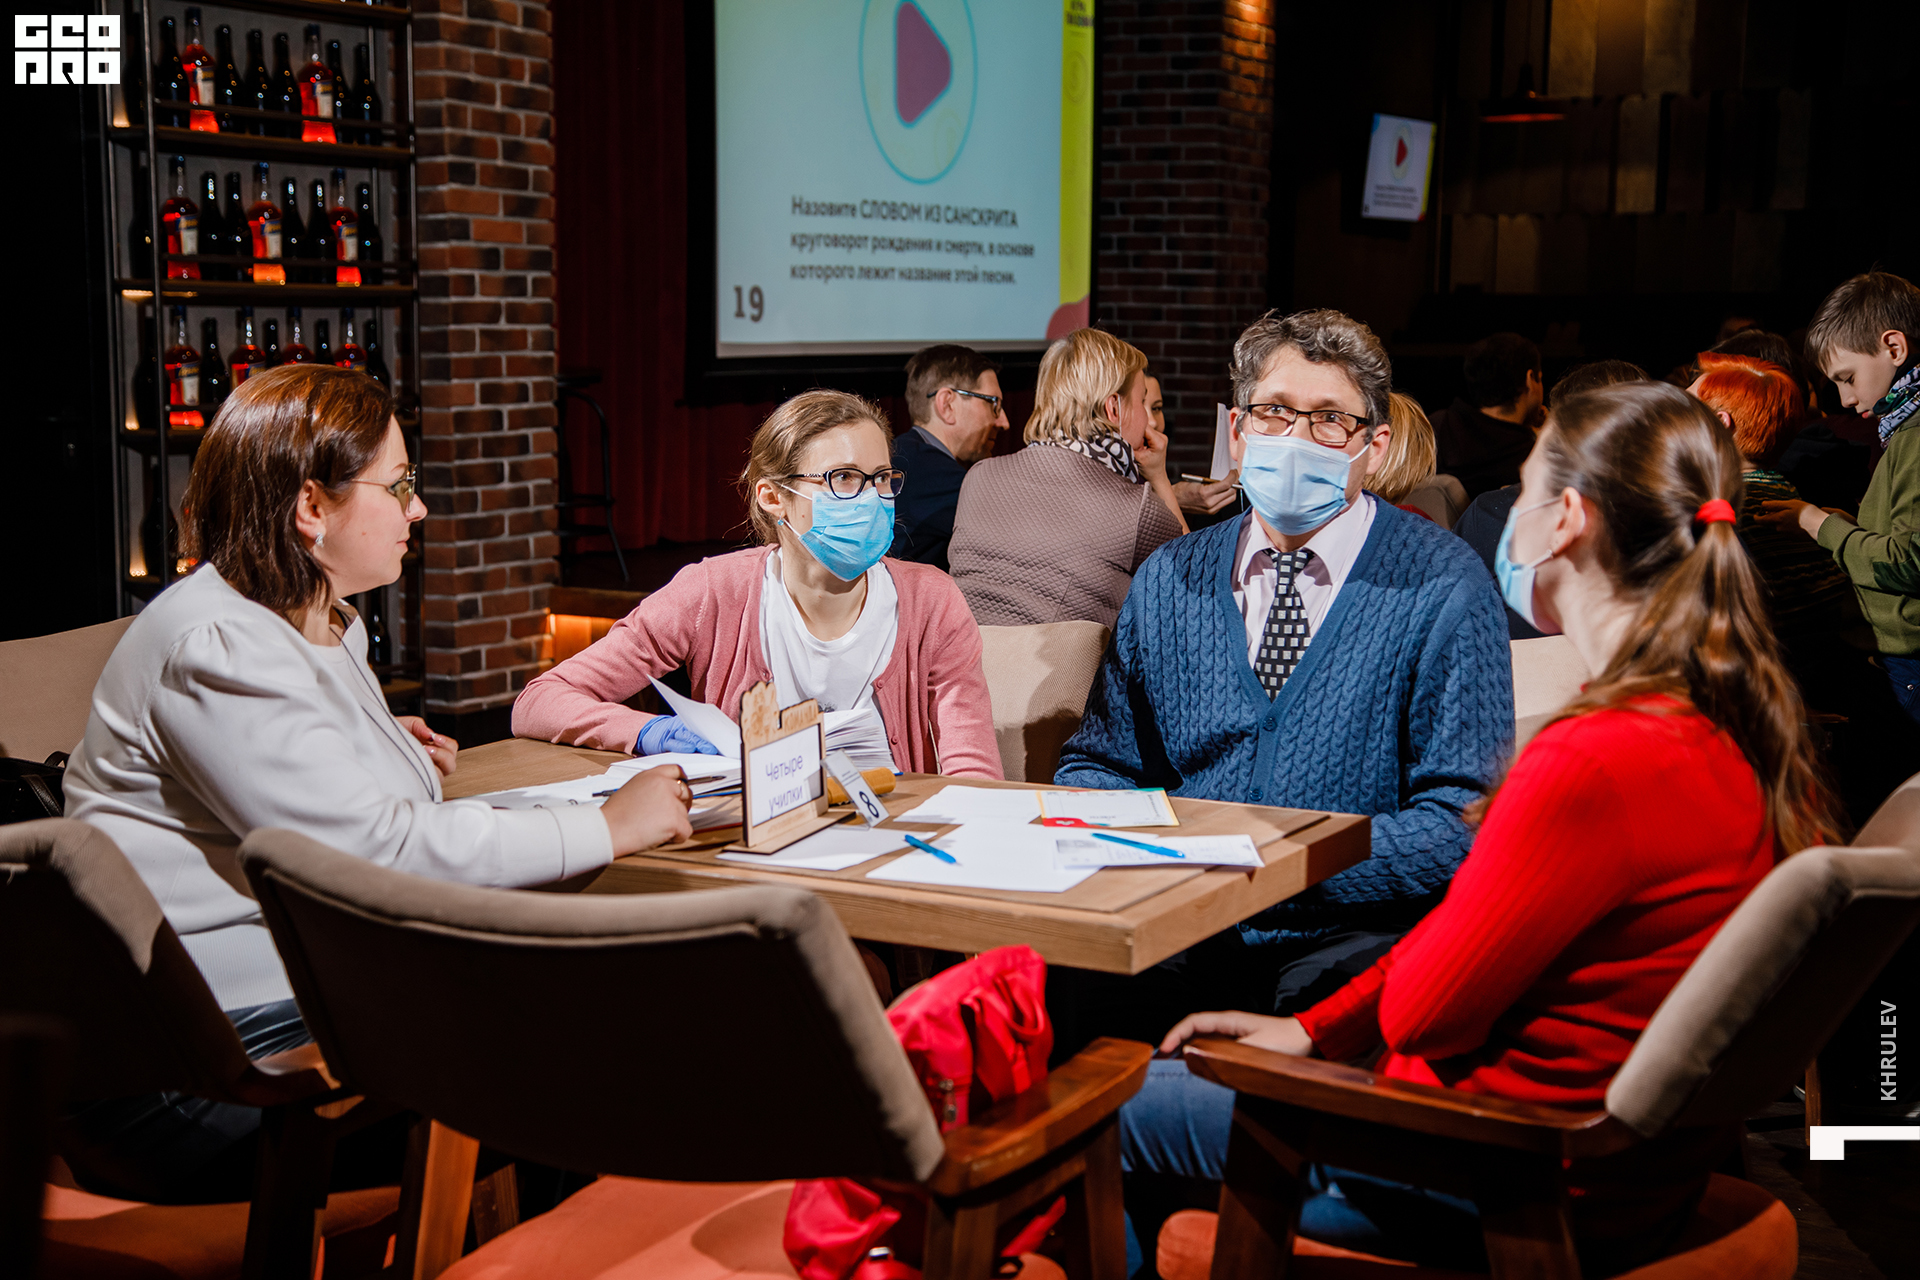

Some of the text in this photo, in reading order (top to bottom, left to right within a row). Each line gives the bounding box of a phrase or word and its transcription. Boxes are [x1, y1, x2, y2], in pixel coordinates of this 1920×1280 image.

[792, 196, 1018, 227] Назовите СЛОВОМ ИЗ САНСКРИТА
[791, 233, 869, 252] круговорот
[871, 235, 932, 254] рождения
[945, 241, 985, 258] смерти,
[998, 243, 1035, 257] основе
[791, 265, 854, 285] которого
[857, 266, 896, 280] лежит
[898, 267, 951, 282] название
[955, 265, 979, 283] этой
[733, 285, 764, 323] 19
[768, 785, 804, 819] училки
[859, 791, 880, 819] 8
